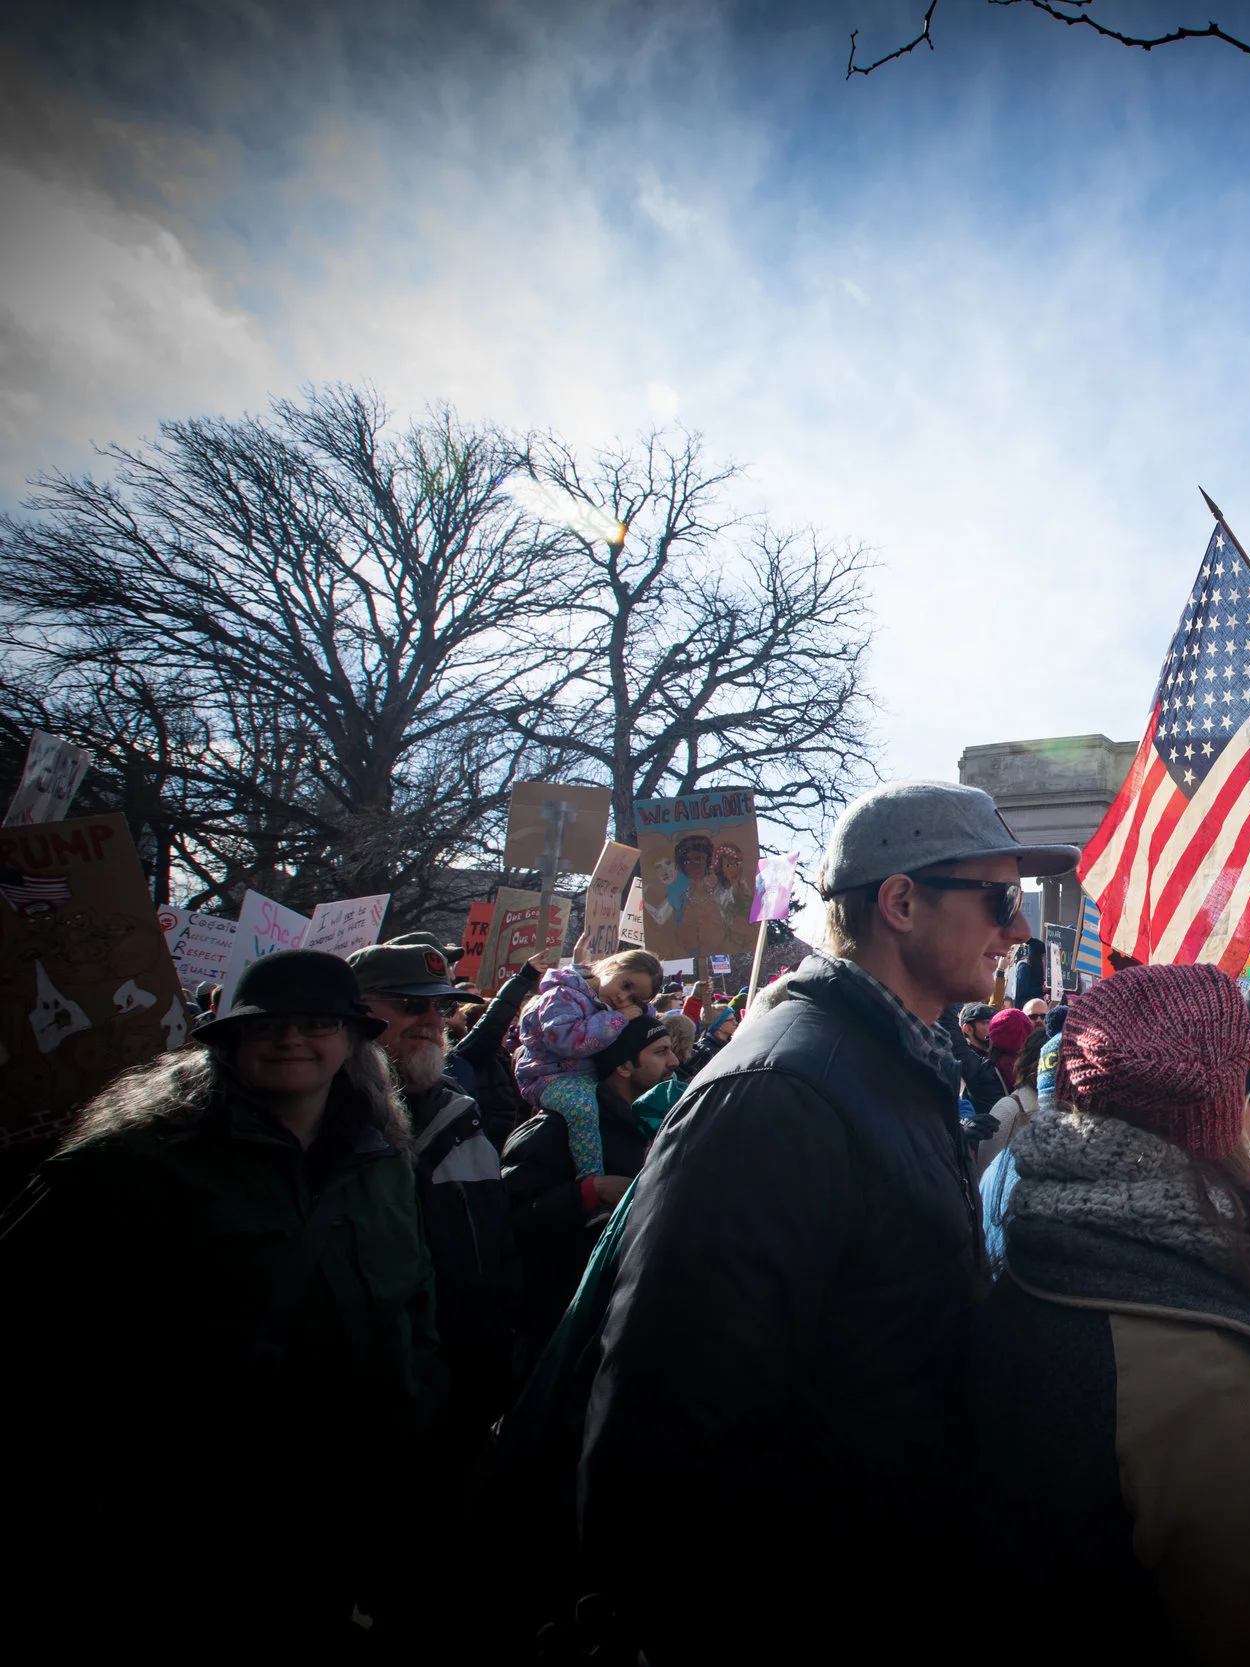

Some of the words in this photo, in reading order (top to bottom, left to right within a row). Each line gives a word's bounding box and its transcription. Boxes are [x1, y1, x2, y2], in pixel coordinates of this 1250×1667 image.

[637, 804, 671, 825] We
[0, 825, 115, 870] RUMP
[627, 913, 642, 924] THE
[180, 927, 233, 949] ACCEPTANC
[621, 928, 644, 942] RESI
[173, 941, 226, 963] RESPECT
